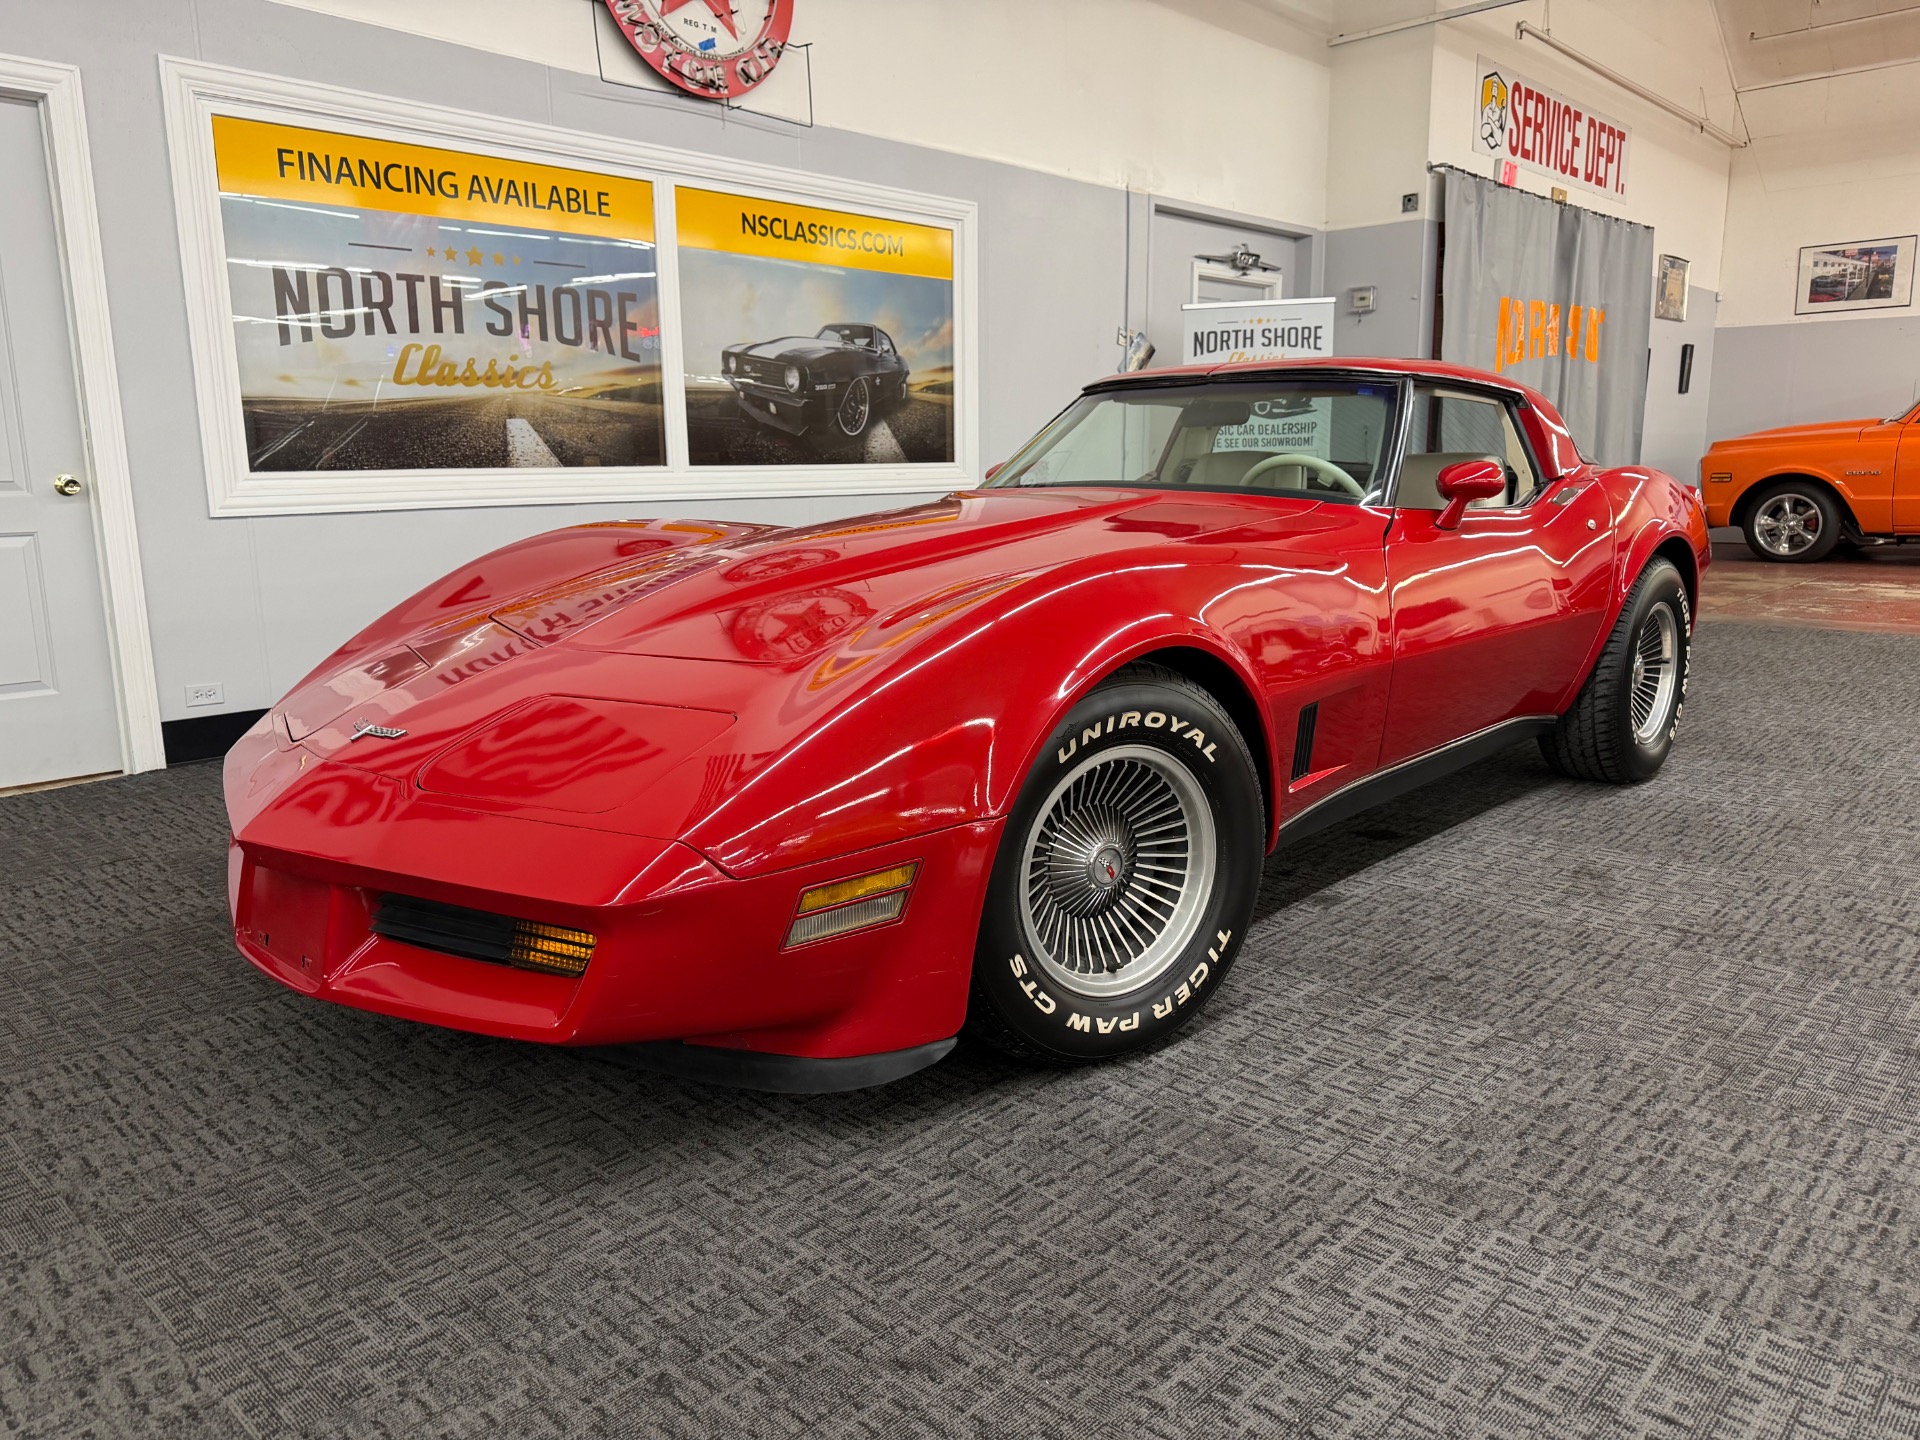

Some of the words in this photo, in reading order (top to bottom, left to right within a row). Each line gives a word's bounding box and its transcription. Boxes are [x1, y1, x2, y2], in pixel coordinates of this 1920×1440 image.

[1508, 81, 1583, 179] SERVICE
[1584, 116, 1626, 196] DEPT.
[276, 147, 459, 199] FINANCING
[467, 174, 612, 218] AVAILABLE
[741, 211, 904, 257] NSCLASSICS.COM
[271, 263, 465, 347] NORTH
[483, 279, 641, 363] SHORE
[393, 342, 559, 391] Classics
[1193, 328, 1254, 358] NORTH
[1261, 325, 1323, 351] SHORE
[1224, 438, 1239, 448] SEE
[1241, 437, 1259, 448] OUR
[1261, 436, 1313, 448] SHOWROOM!
[1236, 424, 1255, 436] CAR
[1258, 421, 1318, 436] DEALERSHIP
[1057, 710, 1218, 764] UNIROYAL
[1008, 953, 1057, 1016] GTS
[1151, 929, 1233, 1020] TIGER
[1065, 1011, 1140, 1035] PAW
